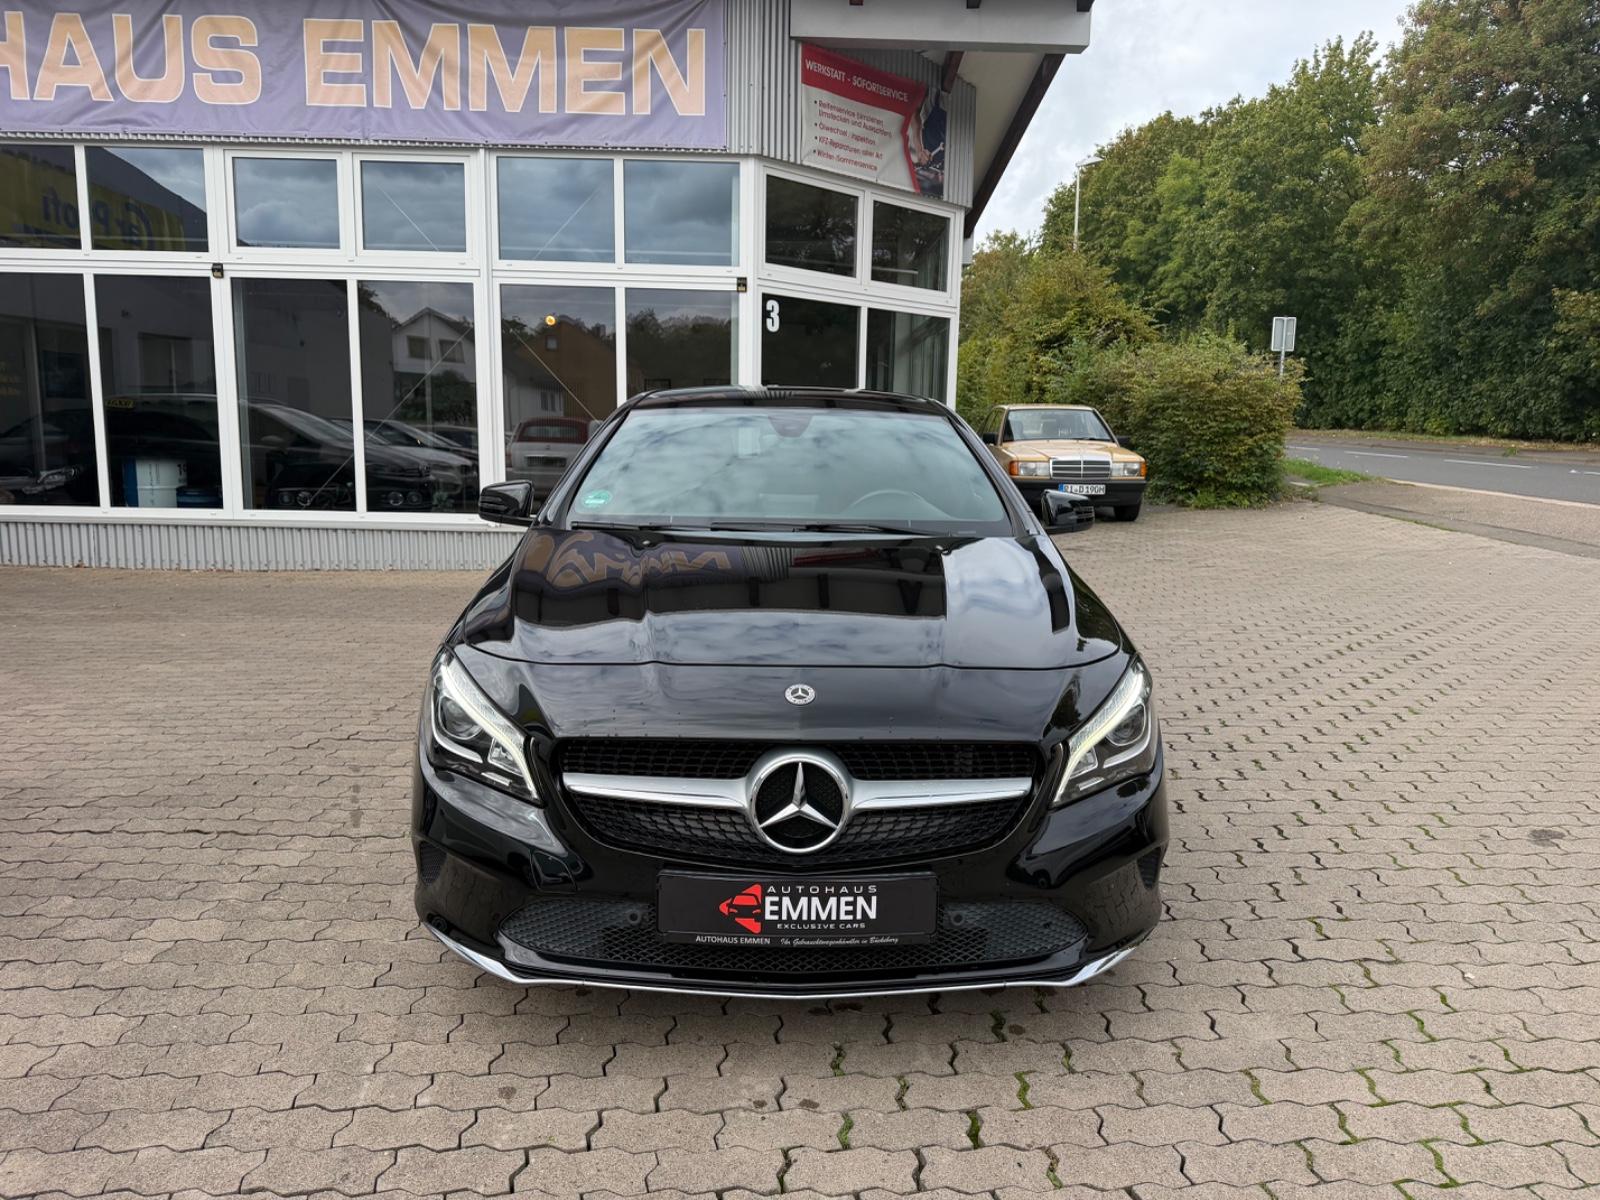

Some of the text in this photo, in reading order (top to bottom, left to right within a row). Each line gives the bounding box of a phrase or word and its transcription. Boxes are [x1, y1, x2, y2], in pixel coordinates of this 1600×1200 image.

[303, 17, 706, 117] EMMEN
[805, 59, 846, 82] WERKSTATT
[852, 75, 909, 103] SOFORTSERVICE
[818, 100, 857, 118] Reifenservice
[766, 299, 780, 333] 3
[767, 885, 877, 894] AUTOHAUS
[765, 896, 877, 920] EMMEN
[695, 935, 771, 945] AUTOHAUS EMMEN
